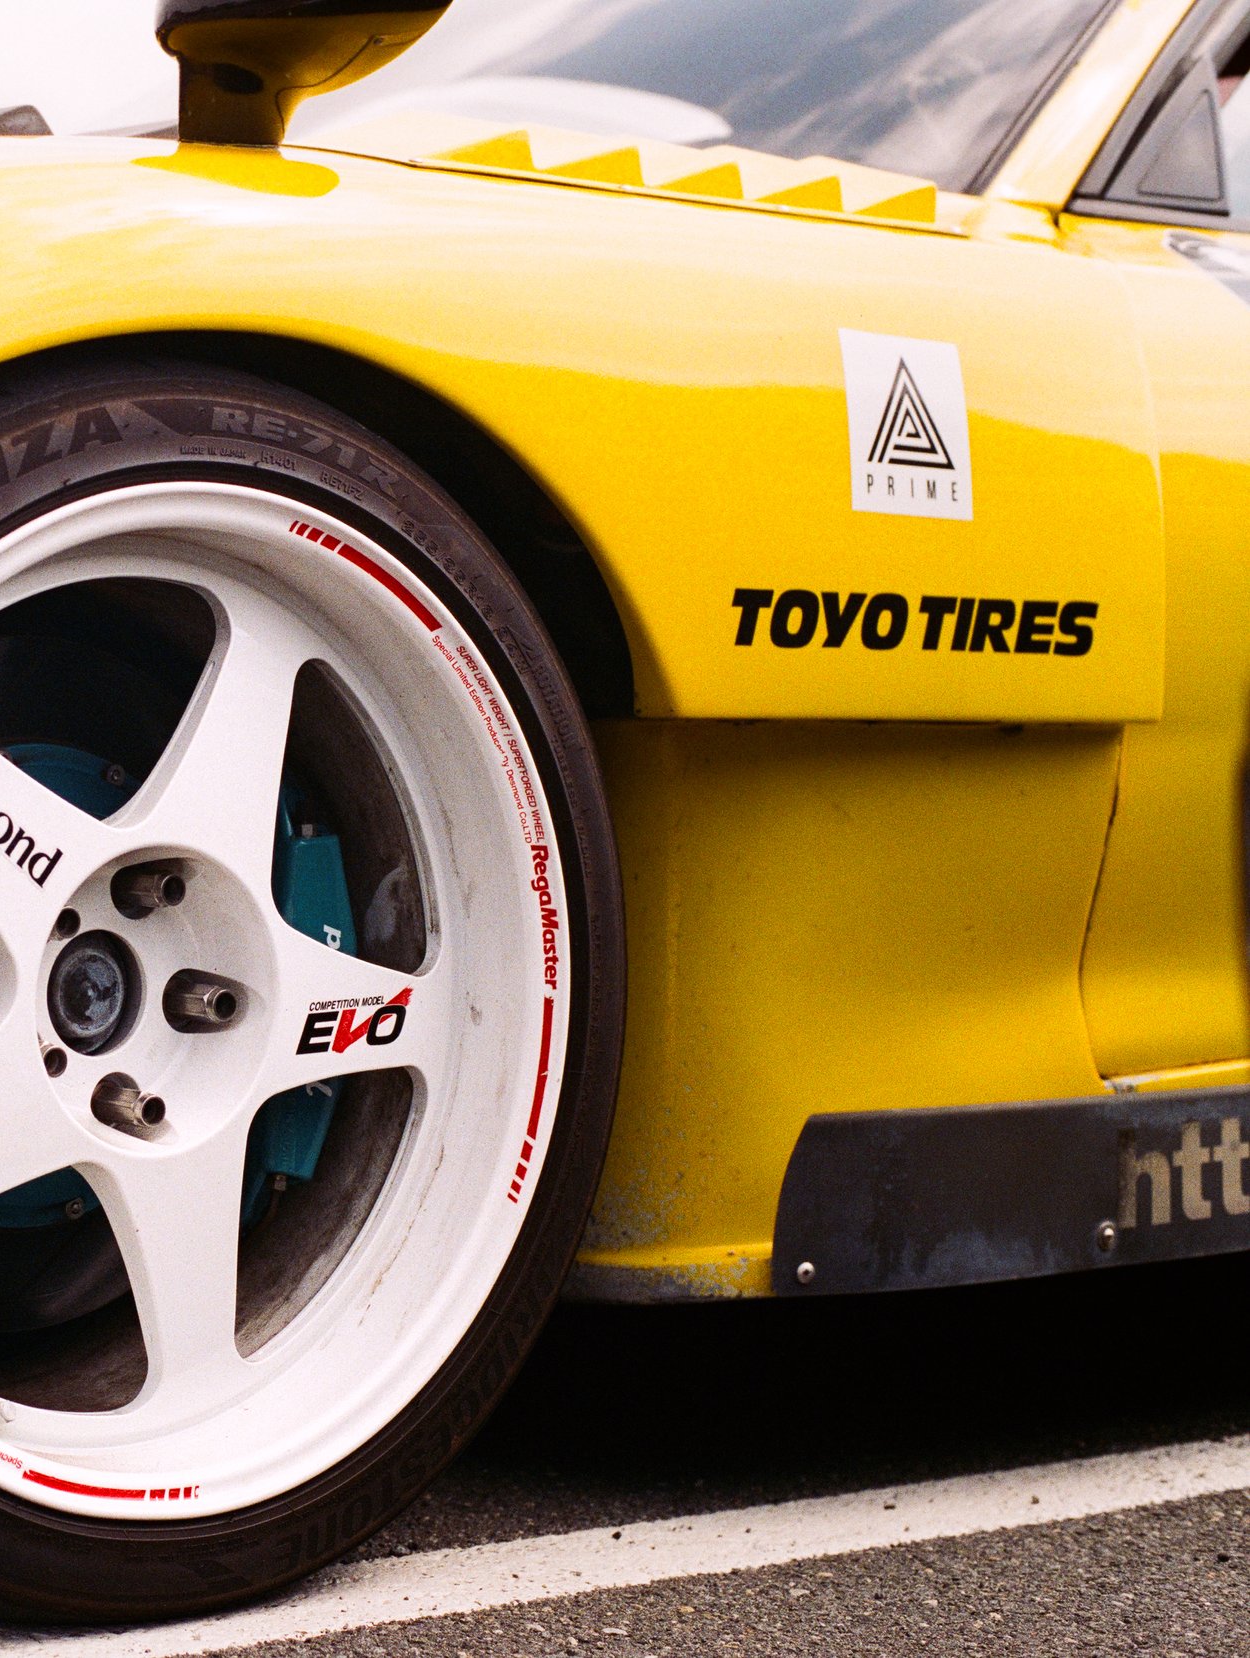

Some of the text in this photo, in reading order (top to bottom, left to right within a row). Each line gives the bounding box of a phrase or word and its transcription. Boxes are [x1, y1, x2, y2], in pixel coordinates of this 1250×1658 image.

[866, 473, 959, 503] PRIME
[731, 588, 1099, 658] TOYO TIRES
[431, 635, 454, 664] Special
[451, 660, 472, 690] Limited
[468, 690, 487, 718] Edition
[456, 645, 478, 673] SUPER
[473, 672, 494, 696] LIGHT
[488, 697, 511, 731] WEIGHT
[530, 844, 560, 990] RegaMaster
[295, 984, 414, 1055] EVO
[308, 995, 386, 1012] COMPETITION MODEL
